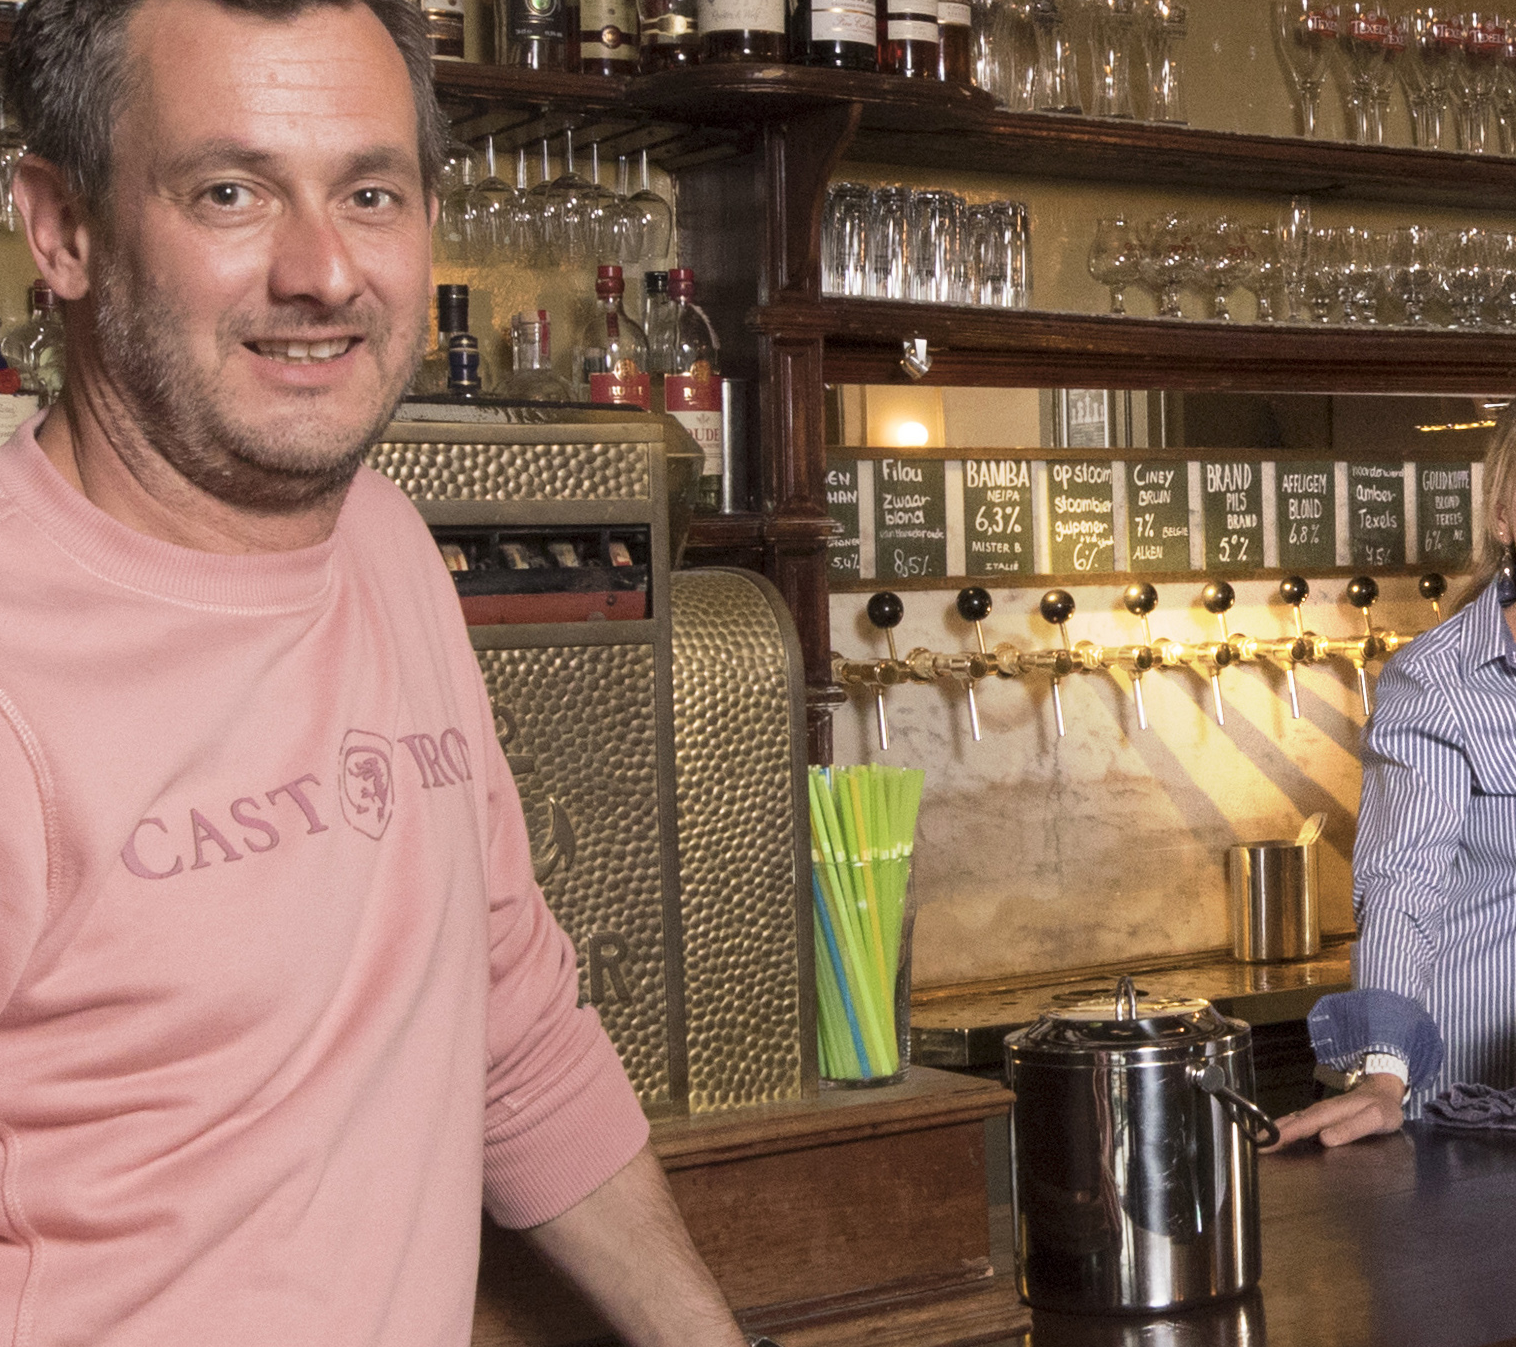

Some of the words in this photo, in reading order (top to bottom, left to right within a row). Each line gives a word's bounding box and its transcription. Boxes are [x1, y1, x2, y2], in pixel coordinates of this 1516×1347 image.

[882, 459, 923, 482] Filou
[966, 459, 1031, 488] BAMBA
[1053, 464, 1073, 491] op
[1206, 463, 1253, 493] BRAND
[1281, 473, 1328, 495] AFFLIGEM
[1356, 484, 1397, 503] amber
[882, 493, 932, 509] Zwaar
[986, 489, 1021, 503] NEIPA
[1054, 495, 1113, 514] stoombier
[1138, 490, 1172, 506] BRUIN
[1226, 492, 1248, 512] PILS
[1435, 495, 1461, 510] BLOND
[885, 510, 925, 526] blond
[1288, 498, 1323, 520] BLOND
[1357, 508, 1399, 529] Texels
[1435, 511, 1464, 526] TEXELS
[975, 505, 1023, 535] 6,3%
[1055, 519, 1109, 542] gulpener
[1134, 513, 1155, 538] 7%
[1227, 514, 1258, 530] BRAND
[971, 541, 1011, 553] MISTER
[1013, 540, 1023, 553] B
[1424, 529, 1443, 553] 6%
[1073, 543, 1099, 571] 6%
[1132, 545, 1163, 560] ALKEN
[120, 772, 330, 881] CAST
